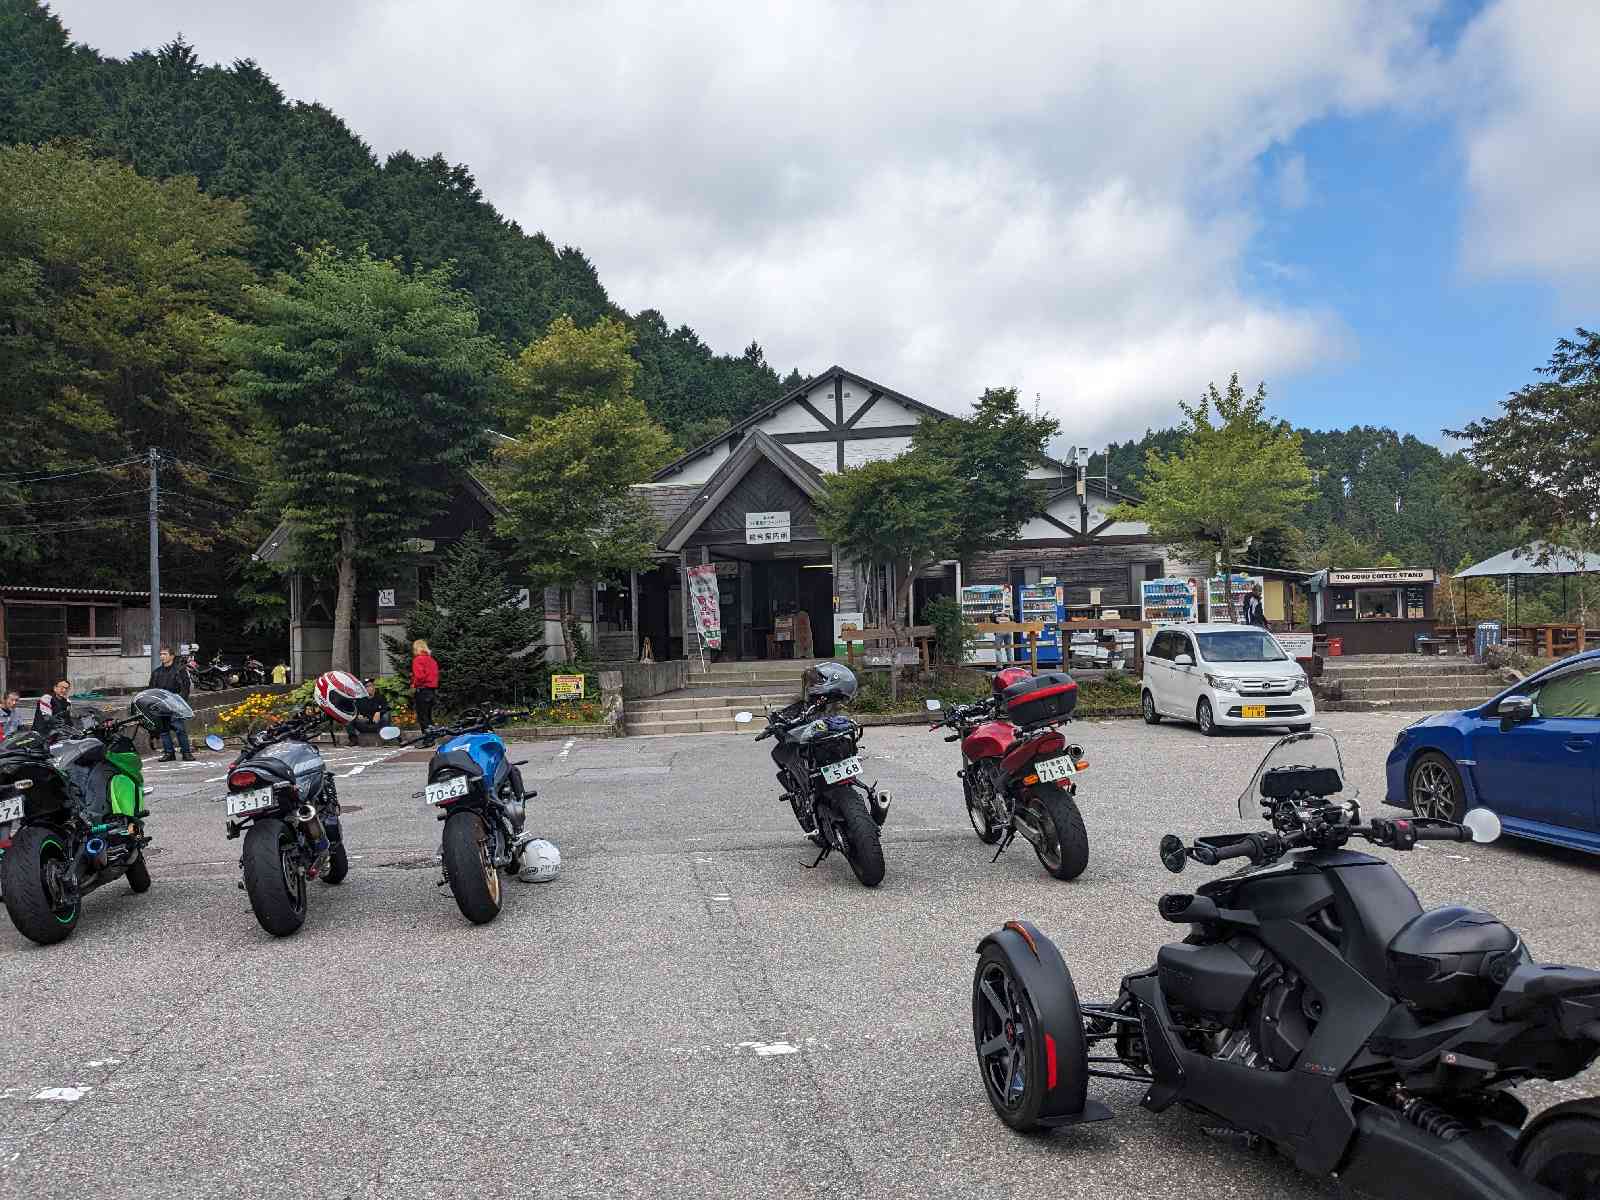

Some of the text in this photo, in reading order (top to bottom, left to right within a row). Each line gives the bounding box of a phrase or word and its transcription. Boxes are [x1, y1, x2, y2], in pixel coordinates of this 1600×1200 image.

[1039, 762, 1073, 781] 71-84
[427, 784, 465, 801] 70-62
[231, 795, 269, 813] 13-19
